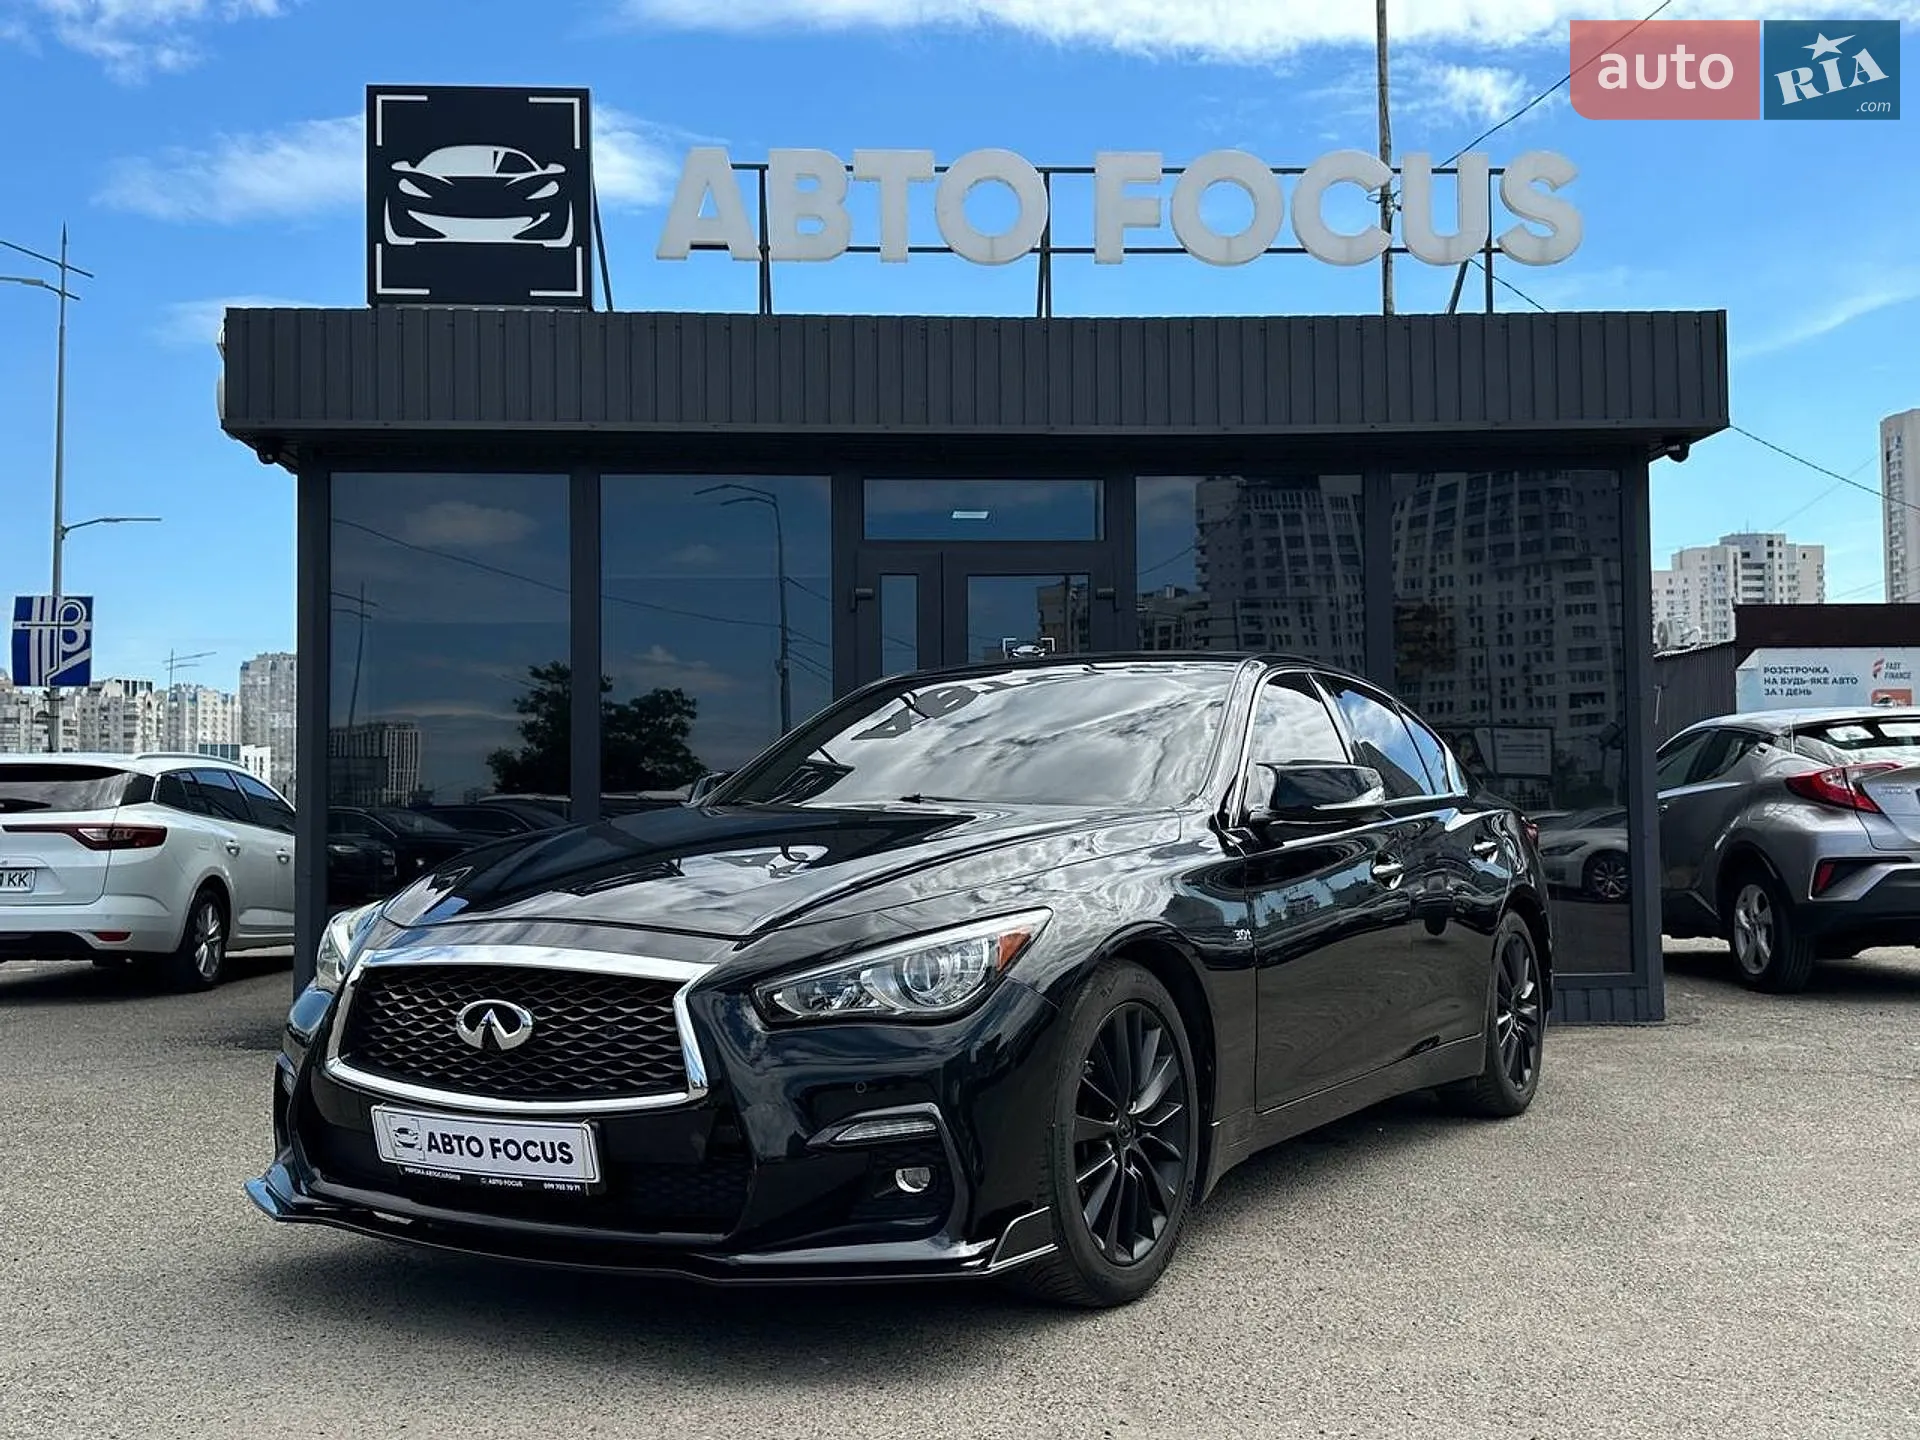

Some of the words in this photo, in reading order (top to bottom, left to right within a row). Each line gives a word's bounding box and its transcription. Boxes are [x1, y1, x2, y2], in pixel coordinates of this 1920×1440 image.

[657, 147, 1049, 266] АВТО
[1094, 149, 1584, 267] FOCUS
[1763, 666, 1829, 674] РОЗСТРОЧКА
[1763, 677, 1778, 685] НА
[1780, 677, 1830, 686] БУДЬ-ЯКЕ
[1831, 677, 1858, 685] АВТО
[1763, 688, 1777, 696] ЗА
[1785, 688, 1812, 697] ДЕНЬ
[426, 1131, 484, 1158] АВТО
[489, 1137, 574, 1165] FOCUS
